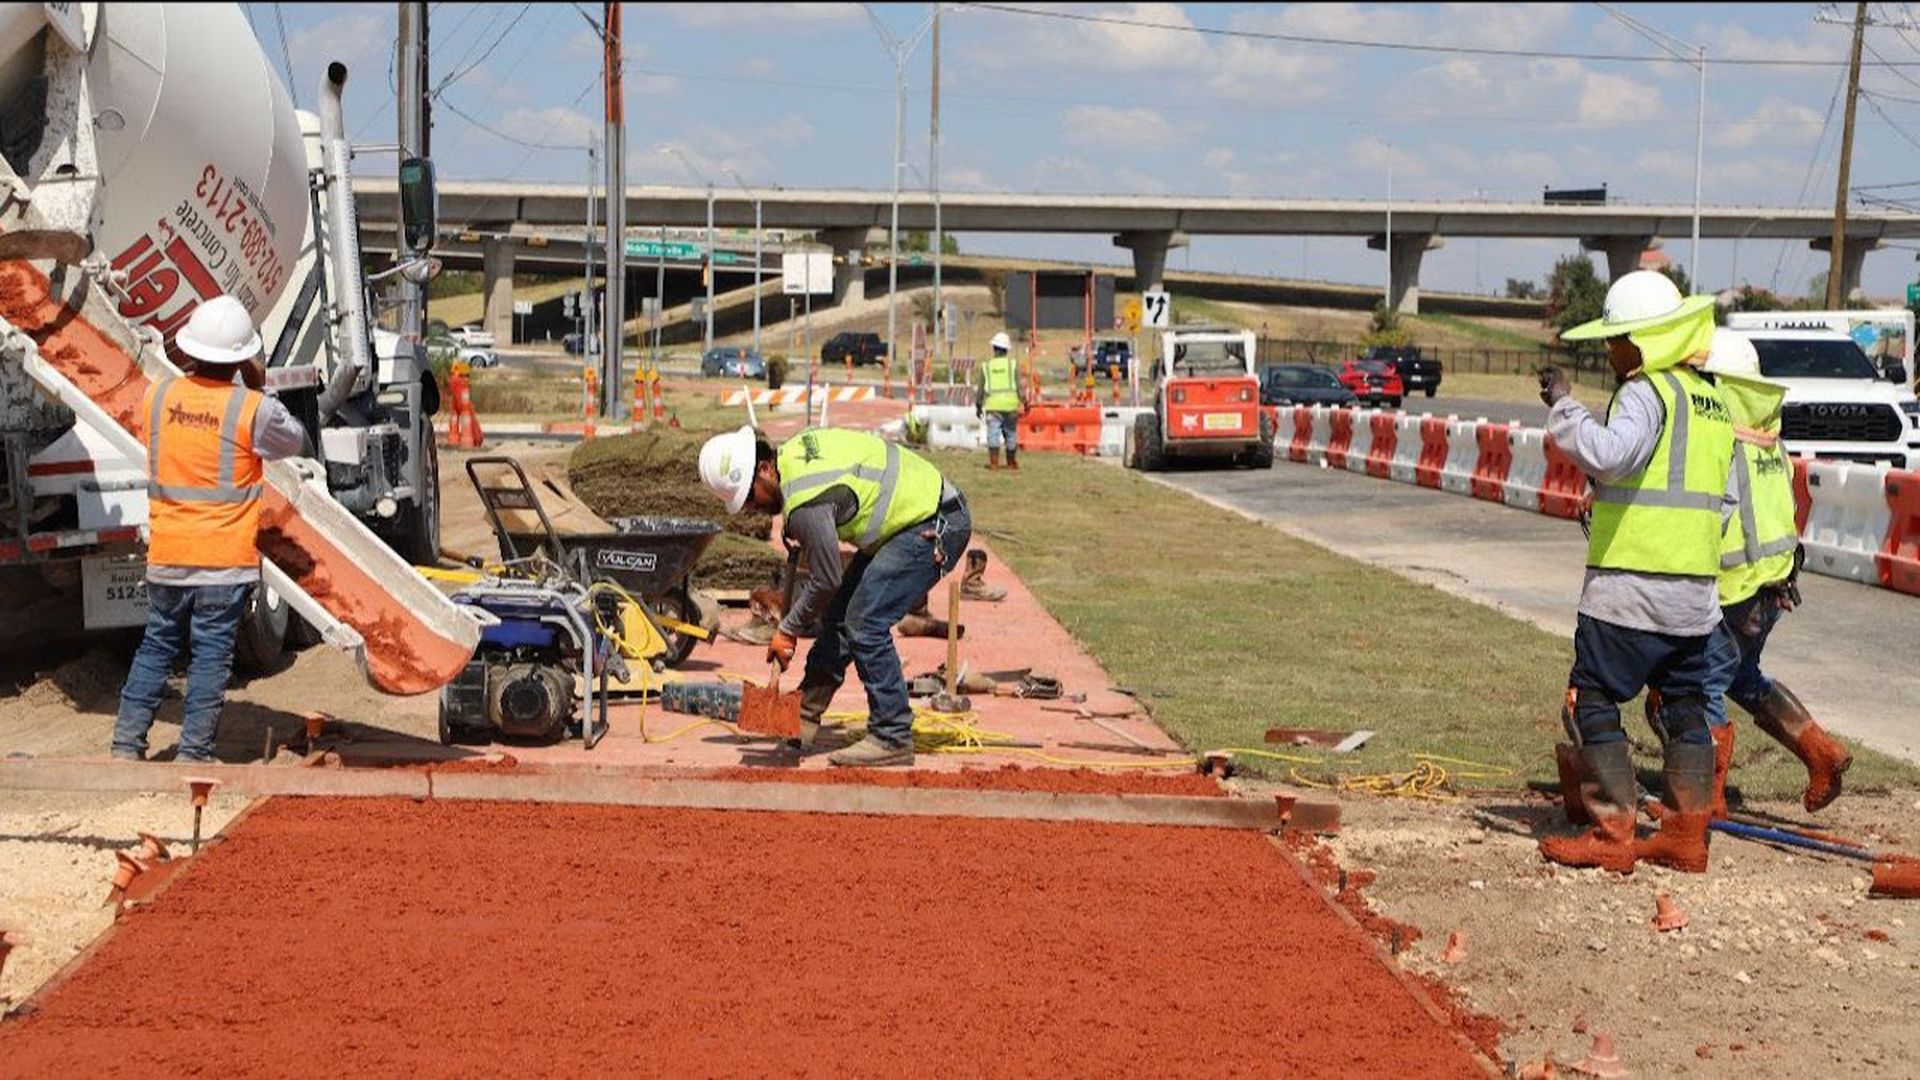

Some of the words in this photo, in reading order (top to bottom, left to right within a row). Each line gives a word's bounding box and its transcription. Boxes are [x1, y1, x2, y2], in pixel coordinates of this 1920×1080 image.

[176, 200, 228, 269] Concrete
[197, 164, 284, 295] 512-389-2113
[1809, 405, 1868, 417] TOYOTA
[600, 553, 653, 568] VULCAN
